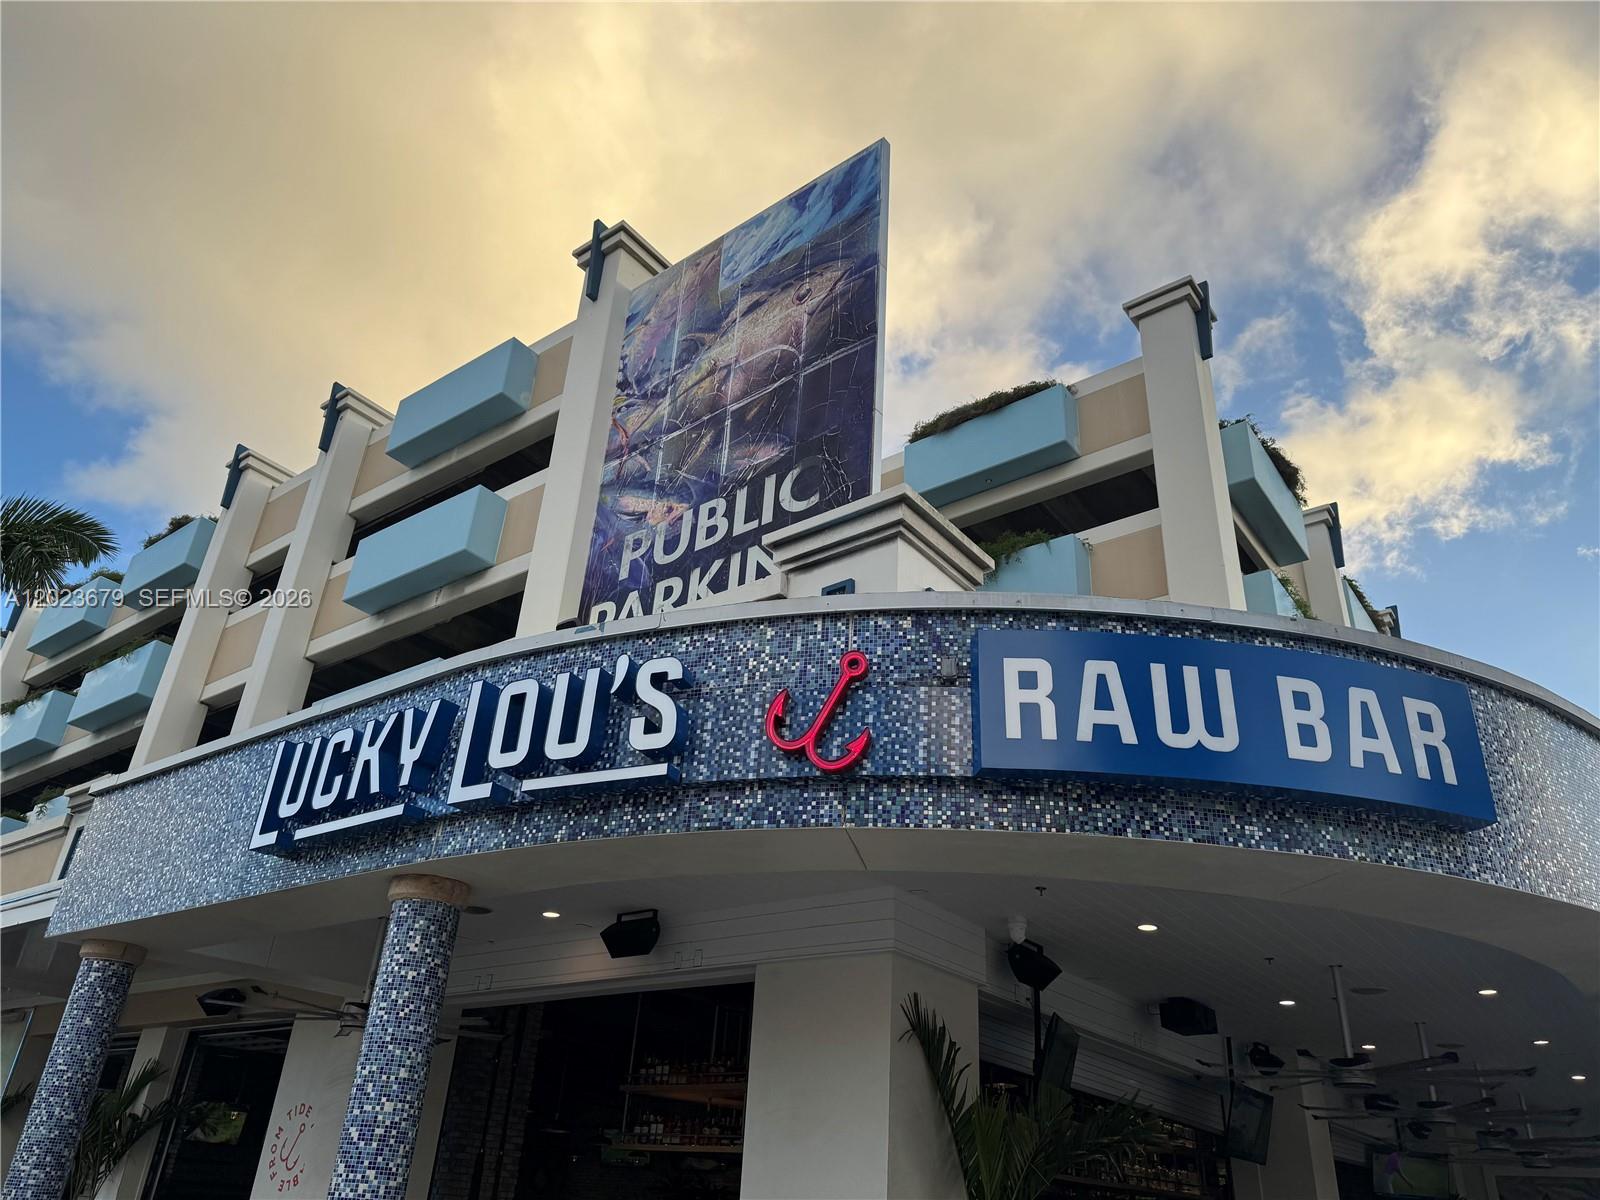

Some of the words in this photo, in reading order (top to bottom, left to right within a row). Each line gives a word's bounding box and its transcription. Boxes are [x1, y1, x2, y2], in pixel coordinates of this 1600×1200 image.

[618, 456, 820, 581] PUBLIC
[589, 545, 776, 625] PARKIN
[249, 698, 442, 850] LUCKY
[447, 653, 684, 805] LOU'S
[1002, 657, 1240, 753] RAW
[1275, 675, 1458, 786] BAR
[268, 1126, 284, 1181] FROM
[286, 1103, 313, 1121] TIDE
